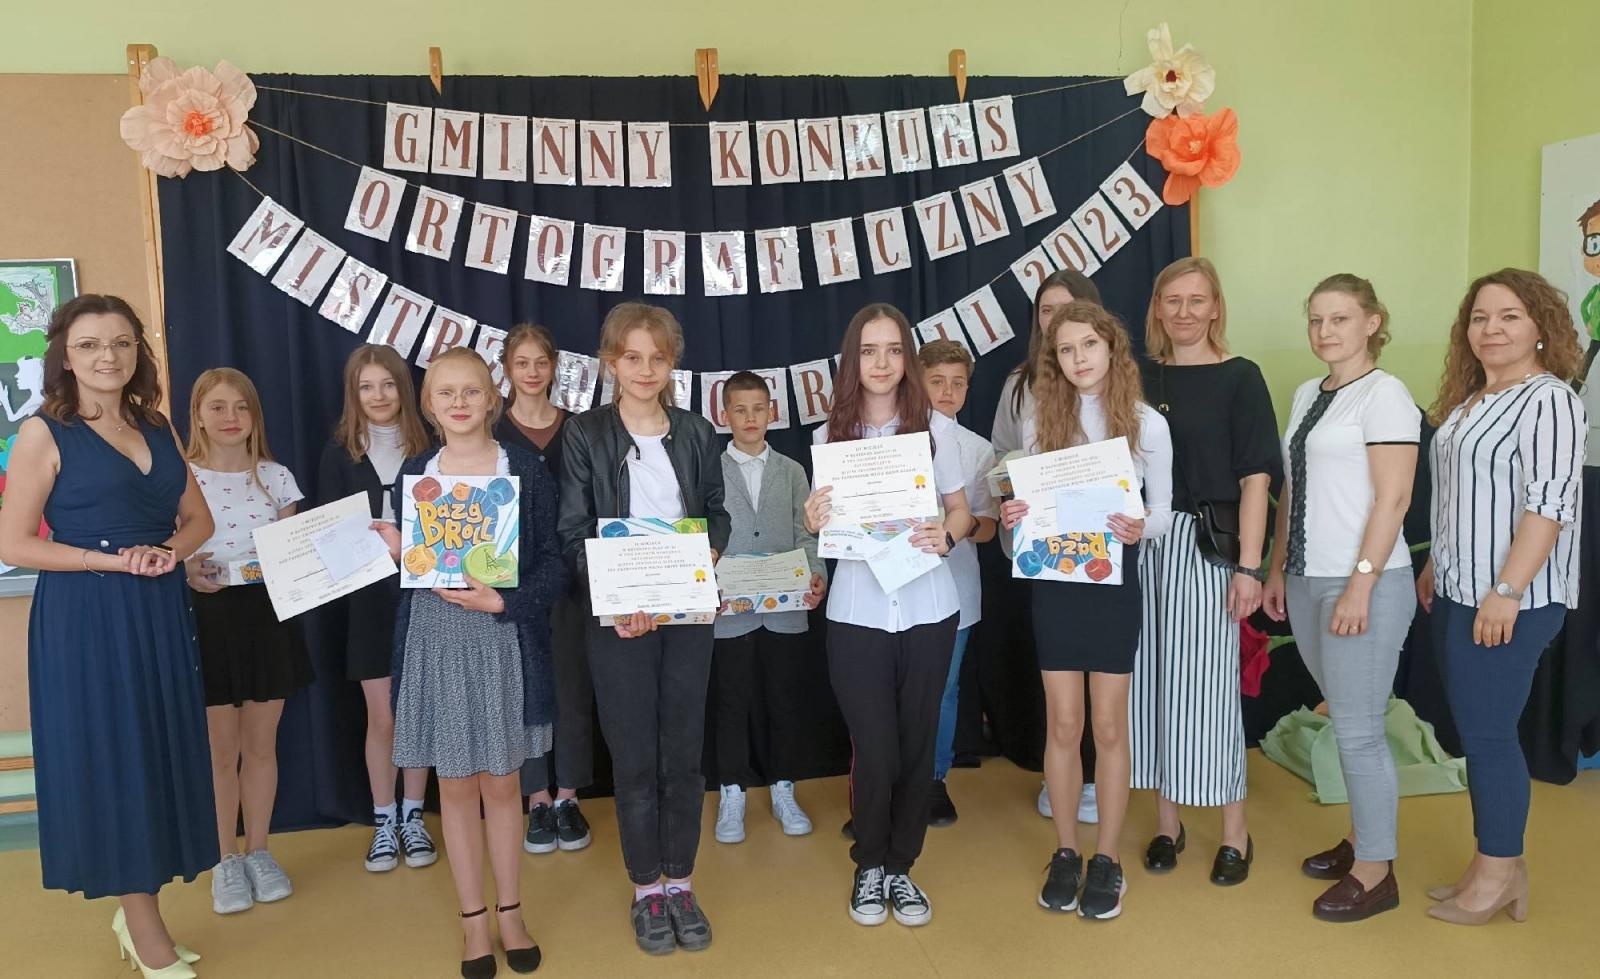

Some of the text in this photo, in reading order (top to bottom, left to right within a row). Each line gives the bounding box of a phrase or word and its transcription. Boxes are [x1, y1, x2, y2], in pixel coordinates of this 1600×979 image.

[394, 104, 1007, 180] GMINNY KONKURS
[359, 167, 1043, 289] ORTOGRAFICZNY
